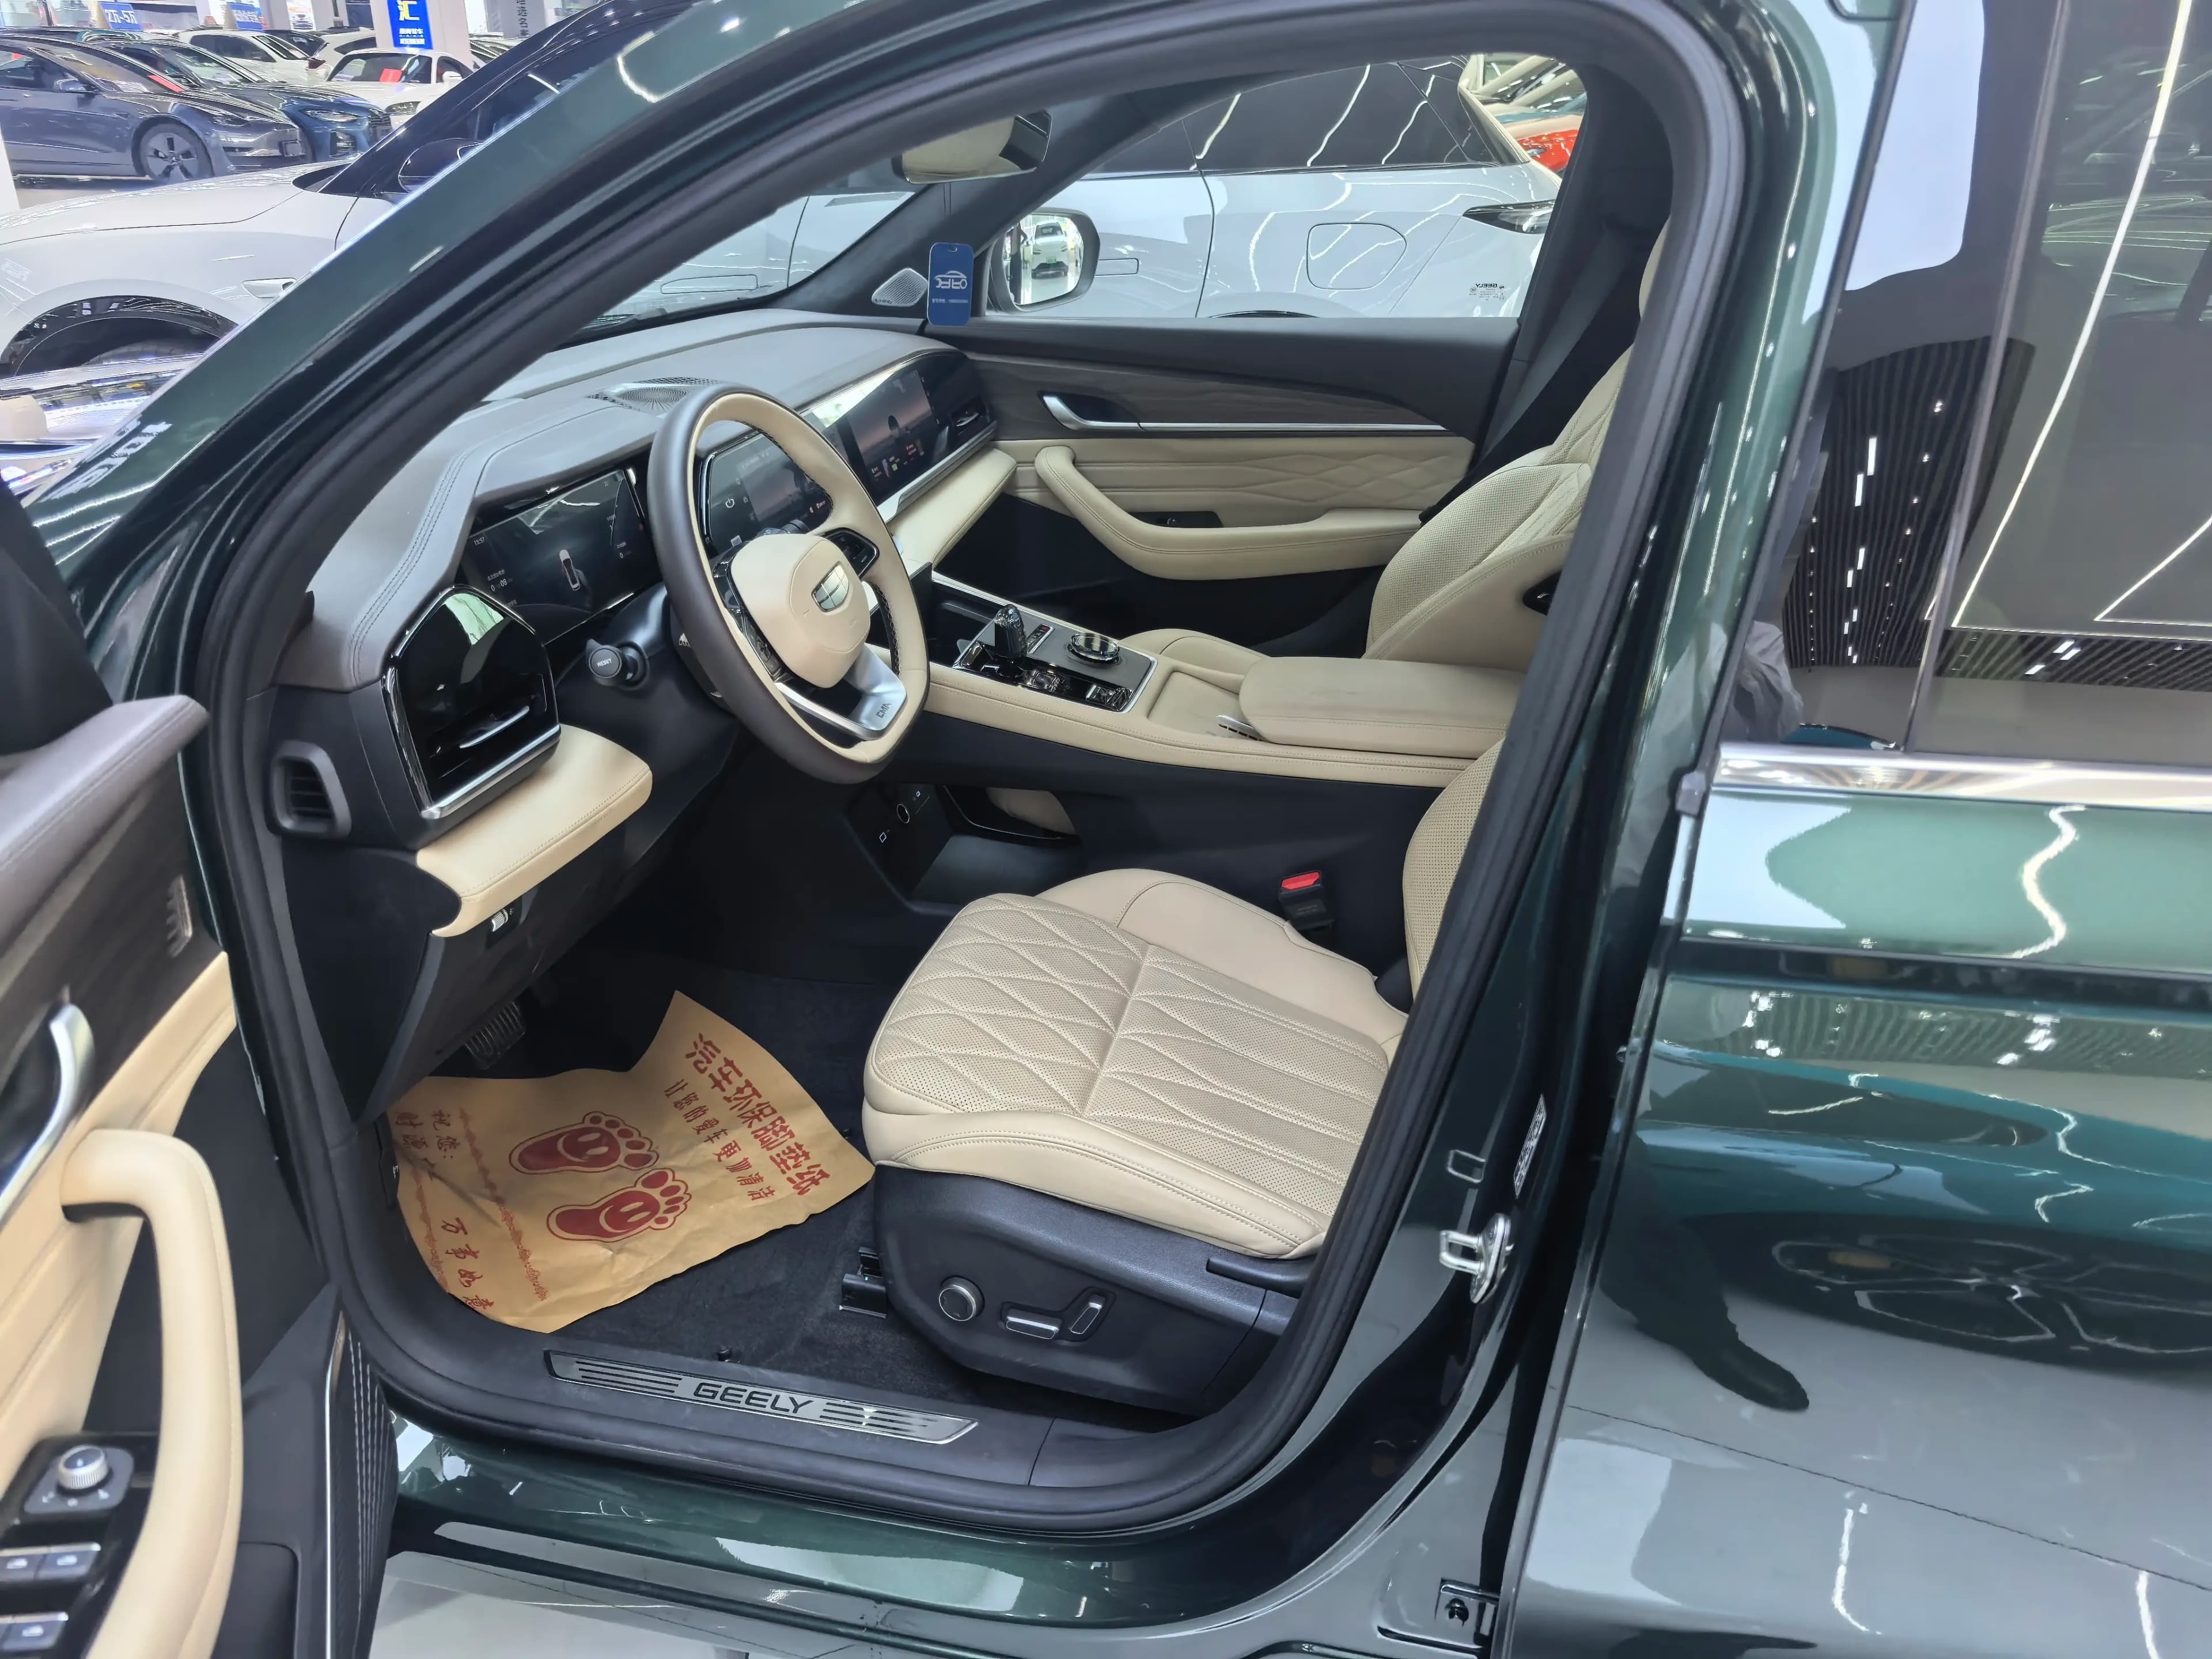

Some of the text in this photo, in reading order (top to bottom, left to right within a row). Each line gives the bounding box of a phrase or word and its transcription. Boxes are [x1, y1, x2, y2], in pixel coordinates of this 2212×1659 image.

[597, 658, 612, 668] RESET
[664, 1078, 775, 1201] 让您的爱车更加清洁
[685, 1032, 831, 1196] 汽车环保脚垫纸
[693, 1382, 815, 1414] GEELY
